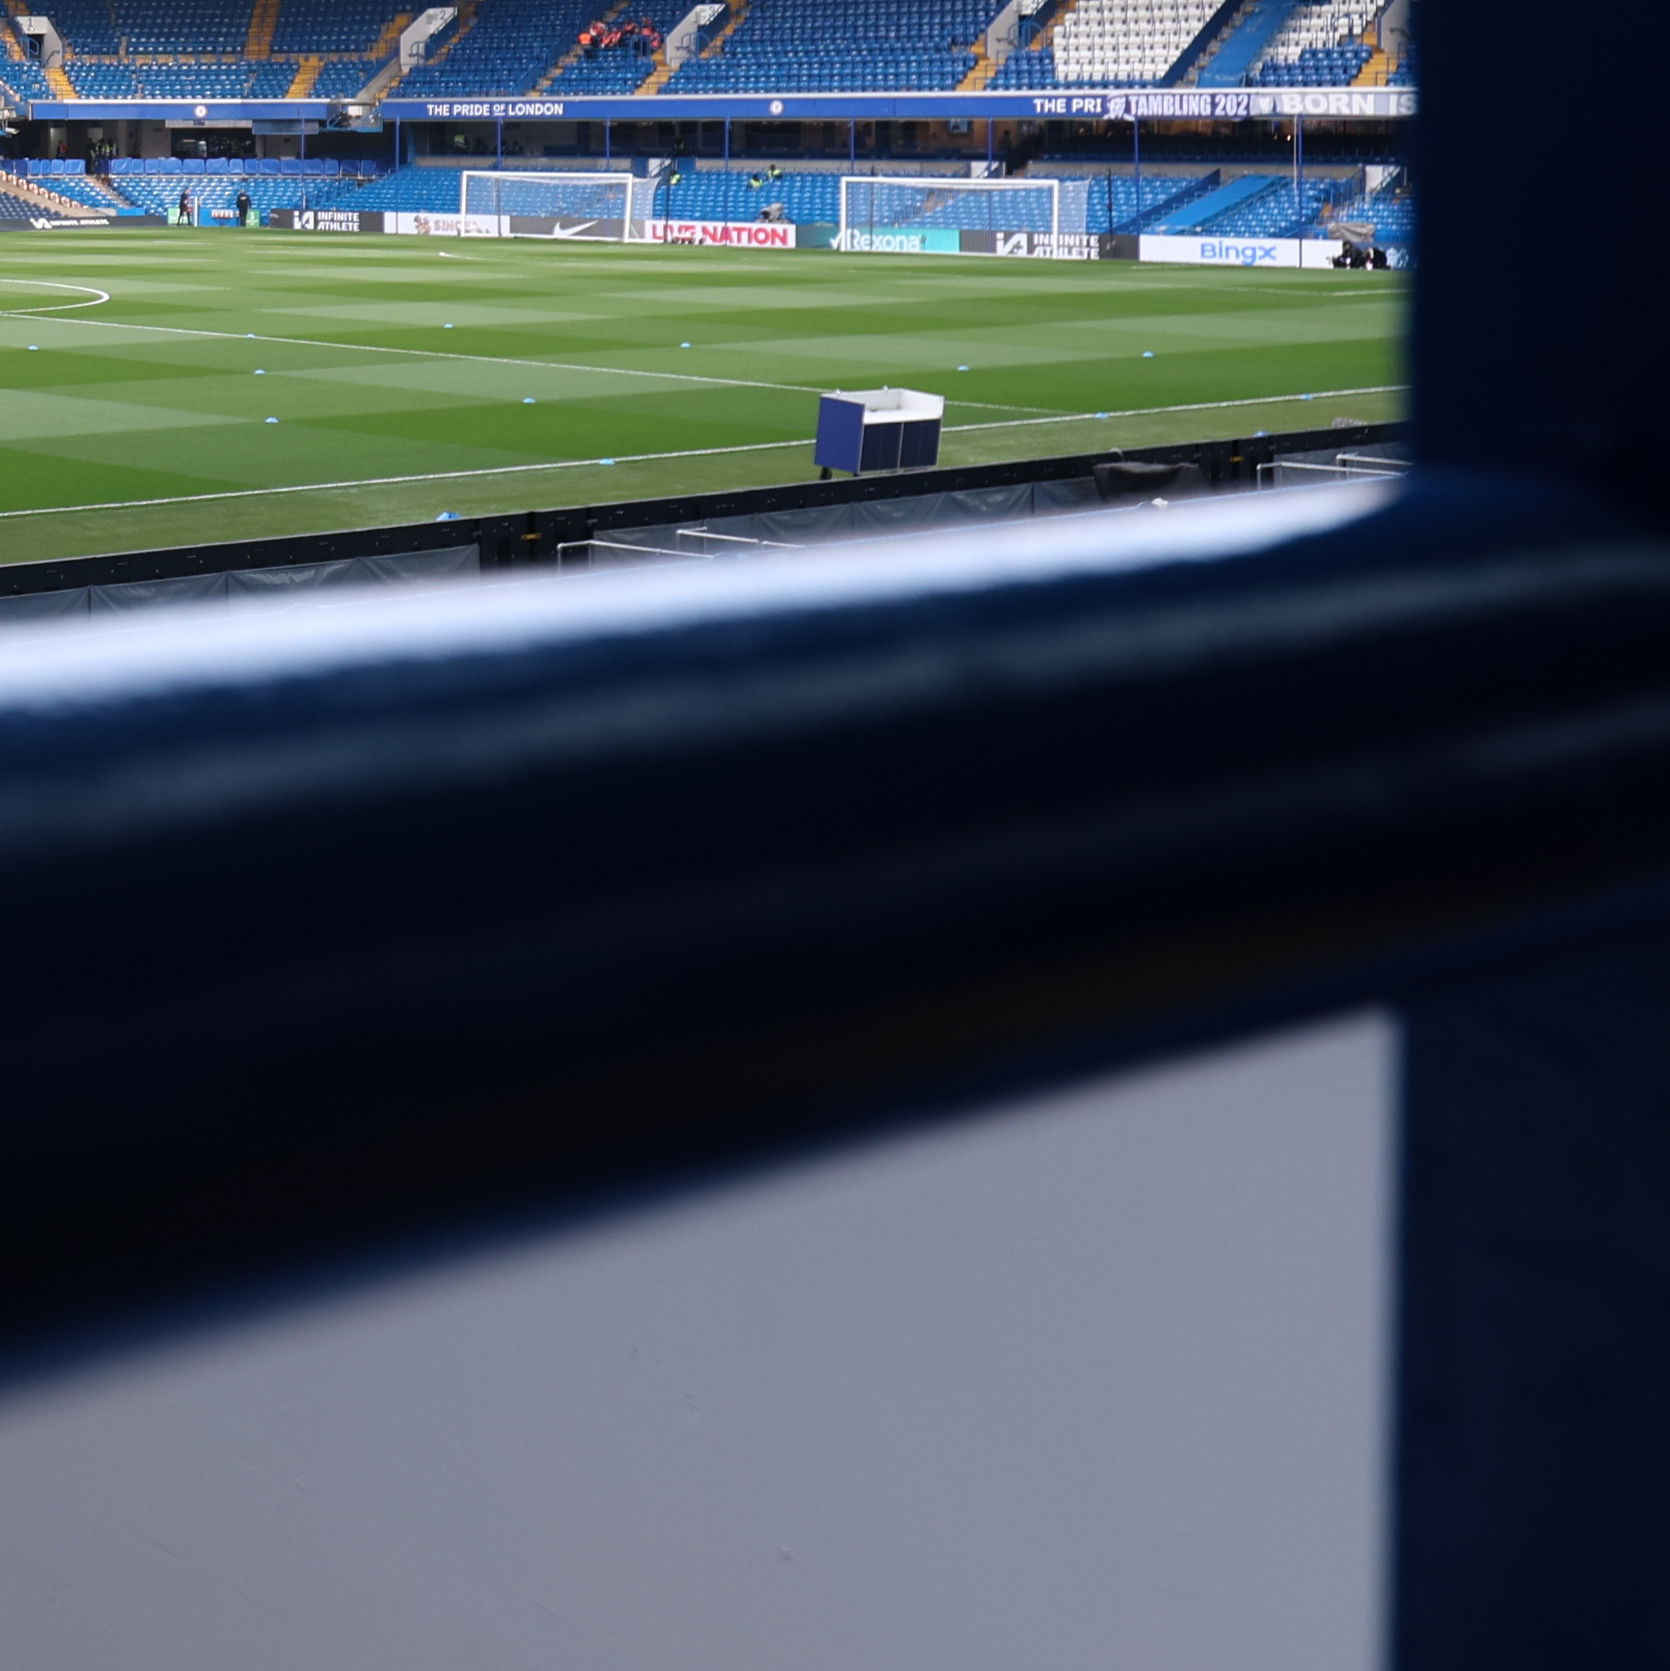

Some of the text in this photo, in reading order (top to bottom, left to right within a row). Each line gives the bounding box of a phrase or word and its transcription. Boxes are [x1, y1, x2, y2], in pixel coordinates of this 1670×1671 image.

[427, 103, 564, 116] THE PRIDE OF LONDON
[1033, 98, 1103, 114] THE PRI
[1128, 94, 1212, 117] TAMBLING
[1281, 93, 1375, 116] BORN
[317, 212, 359, 222] INFINITE
[317, 221, 359, 232] ATHLETE
[701, 226, 788, 246] NATION
[847, 228, 921, 251] Rexona
